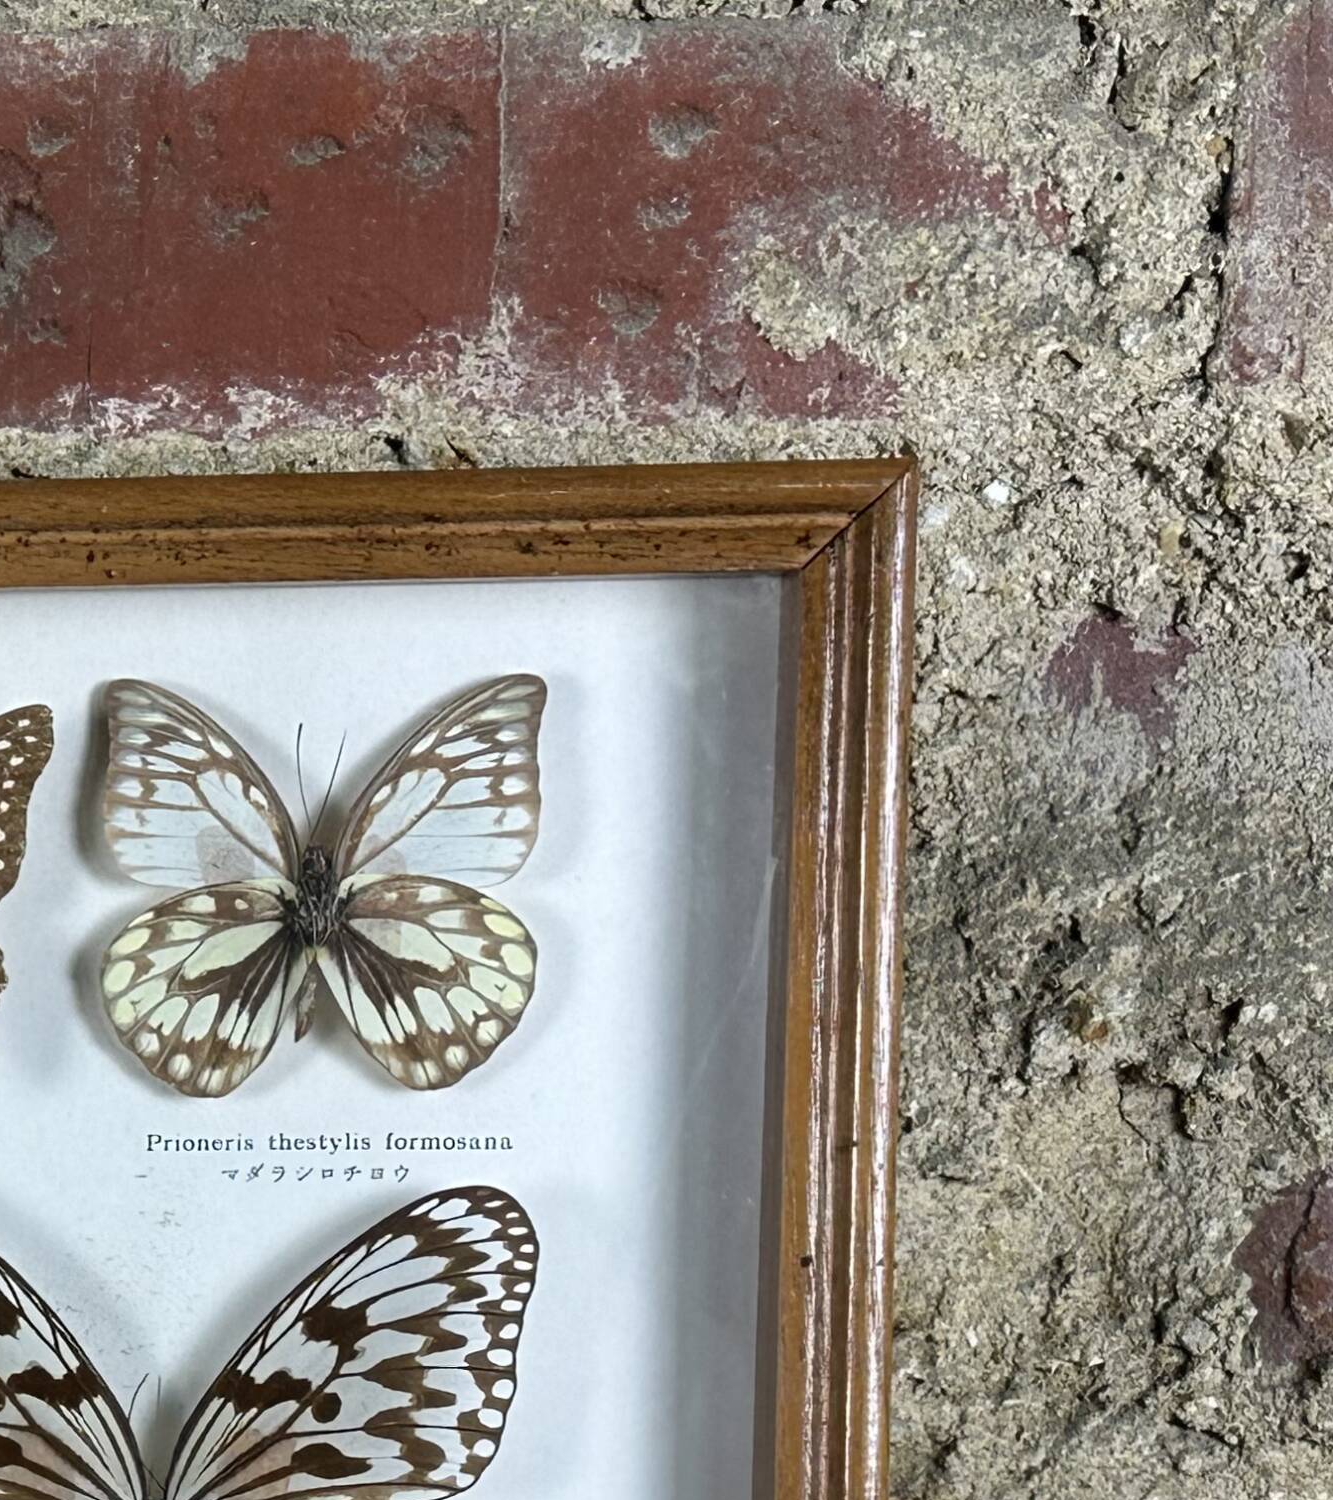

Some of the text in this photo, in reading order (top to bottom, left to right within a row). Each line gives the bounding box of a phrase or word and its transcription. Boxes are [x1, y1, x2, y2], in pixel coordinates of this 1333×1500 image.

[145, 1132, 514, 1155] Prioneris thestylis formosana
